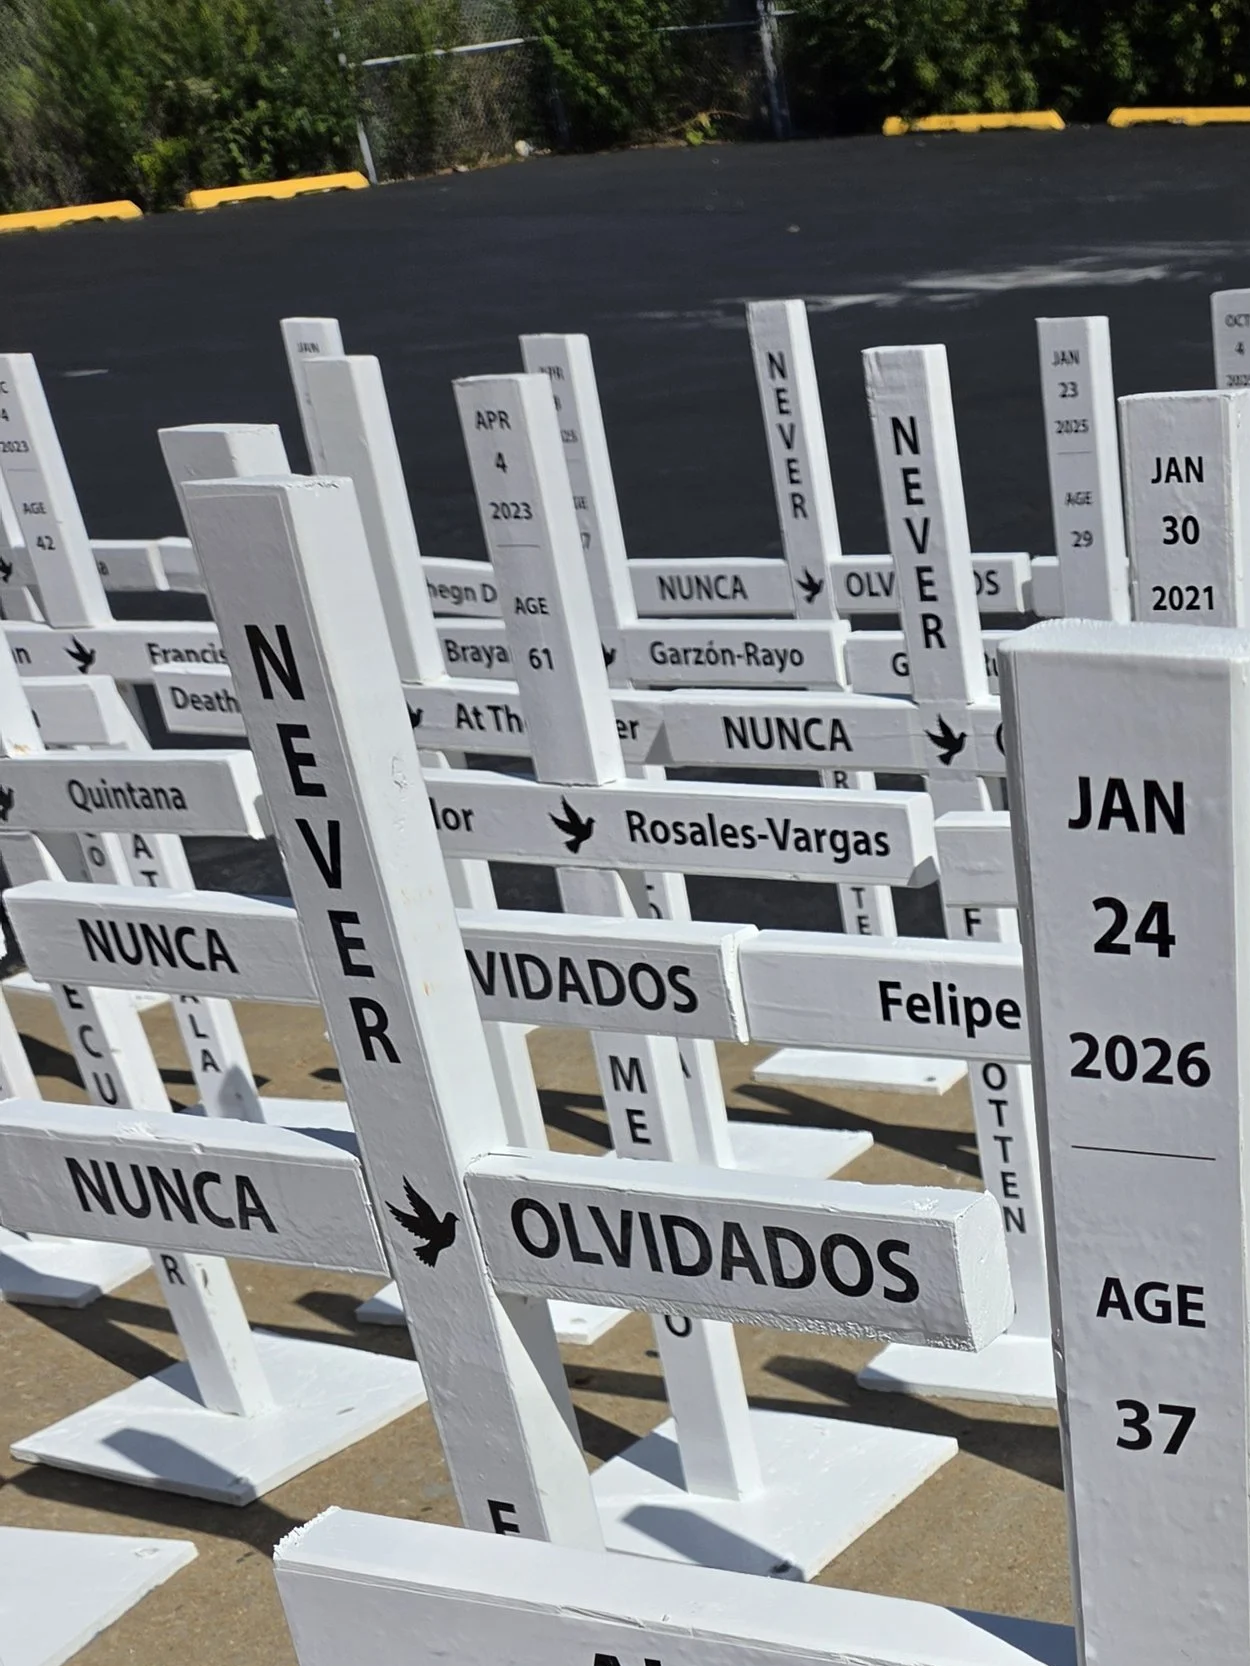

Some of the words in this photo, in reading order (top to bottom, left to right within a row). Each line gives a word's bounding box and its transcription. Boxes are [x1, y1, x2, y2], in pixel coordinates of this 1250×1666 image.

[1225, 313, 1250, 328] OCT
[1052, 350, 1080, 366] JAN
[1234, 341, 1245, 355] 4
[1058, 382, 1079, 399] 23
[475, 411, 512, 430] APR
[767, 352, 808, 519] NEVER
[495, 452, 507, 473] 4
[1151, 455, 1205, 485] JAN
[23, 503, 46, 514] AGE
[489, 502, 533, 521] 2023
[36, 536, 56, 551] 42
[890, 416, 947, 650] NEVER
[1071, 530, 1094, 548] 29
[1162, 515, 1201, 546] 30
[658, 573, 749, 601] NUNCA
[845, 570, 1000, 598] OLVOS
[1151, 584, 1215, 612] 2021
[514, 596, 549, 615] AGE
[444, 639, 510, 669] Braya
[650, 640, 805, 673] Garzón-Rayo
[528, 646, 555, 671] 61
[170, 685, 241, 714] Death
[456, 702, 485, 731] At
[489, 704, 523, 734] Th
[722, 715, 854, 753] NUNCA
[67, 777, 189, 814] Quintana
[1068, 775, 1186, 836] JAN
[244, 624, 402, 1064] NEVER
[624, 808, 891, 865] Rosales-Vargas
[1091, 896, 1176, 959] 24
[77, 918, 241, 975] NUNCA
[465, 948, 699, 1015] VIDADOS
[878, 980, 1021, 1039] Felipe
[1069, 1031, 1212, 1089] 2026
[65, 1157, 280, 1236] NUNCA
[510, 1197, 920, 1305] OLVIDADOS
[1096, 1276, 1206, 1329] AGE
[1115, 1398, 1197, 1455] 37
